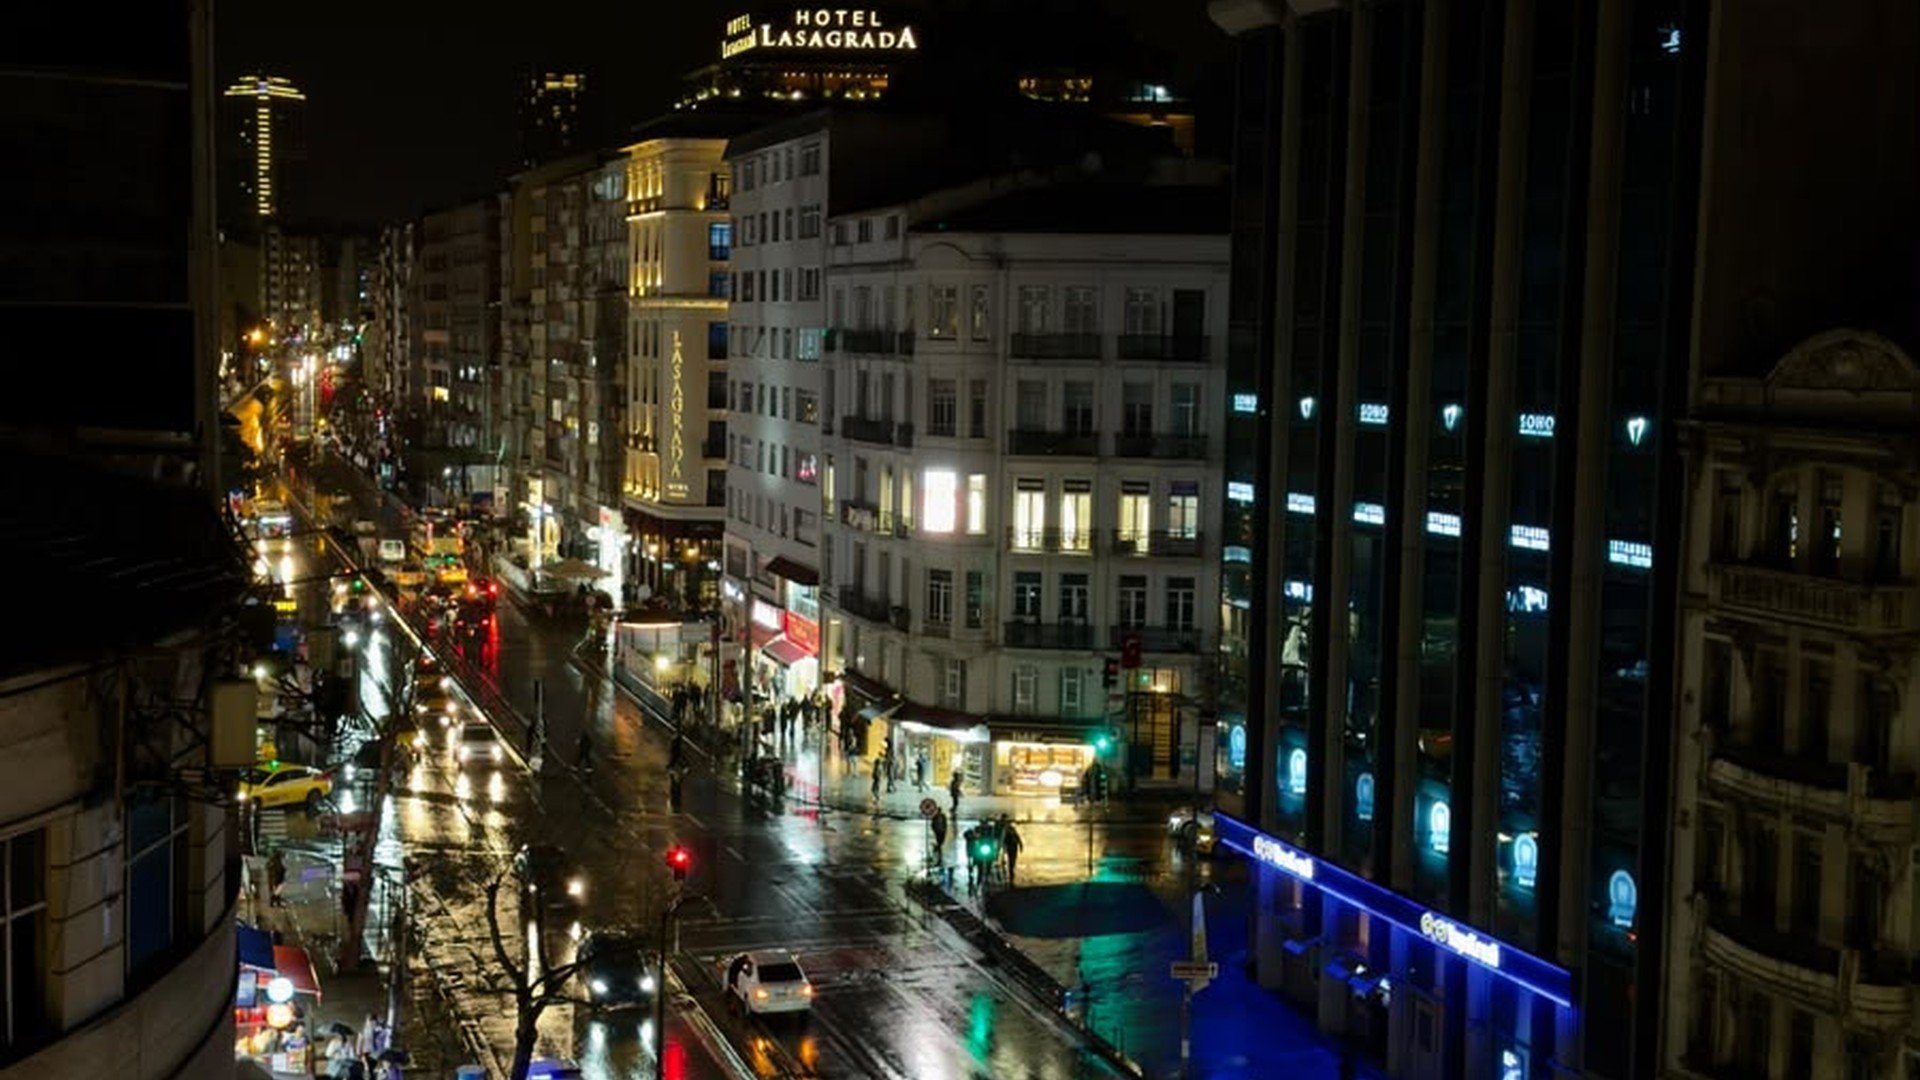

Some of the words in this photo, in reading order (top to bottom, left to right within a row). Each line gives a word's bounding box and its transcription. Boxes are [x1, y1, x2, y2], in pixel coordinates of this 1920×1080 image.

[796, 10, 882, 27] HOTEL
[761, 24, 917, 49] LASAGRADA
[671, 330, 684, 478] LASAGRADA
